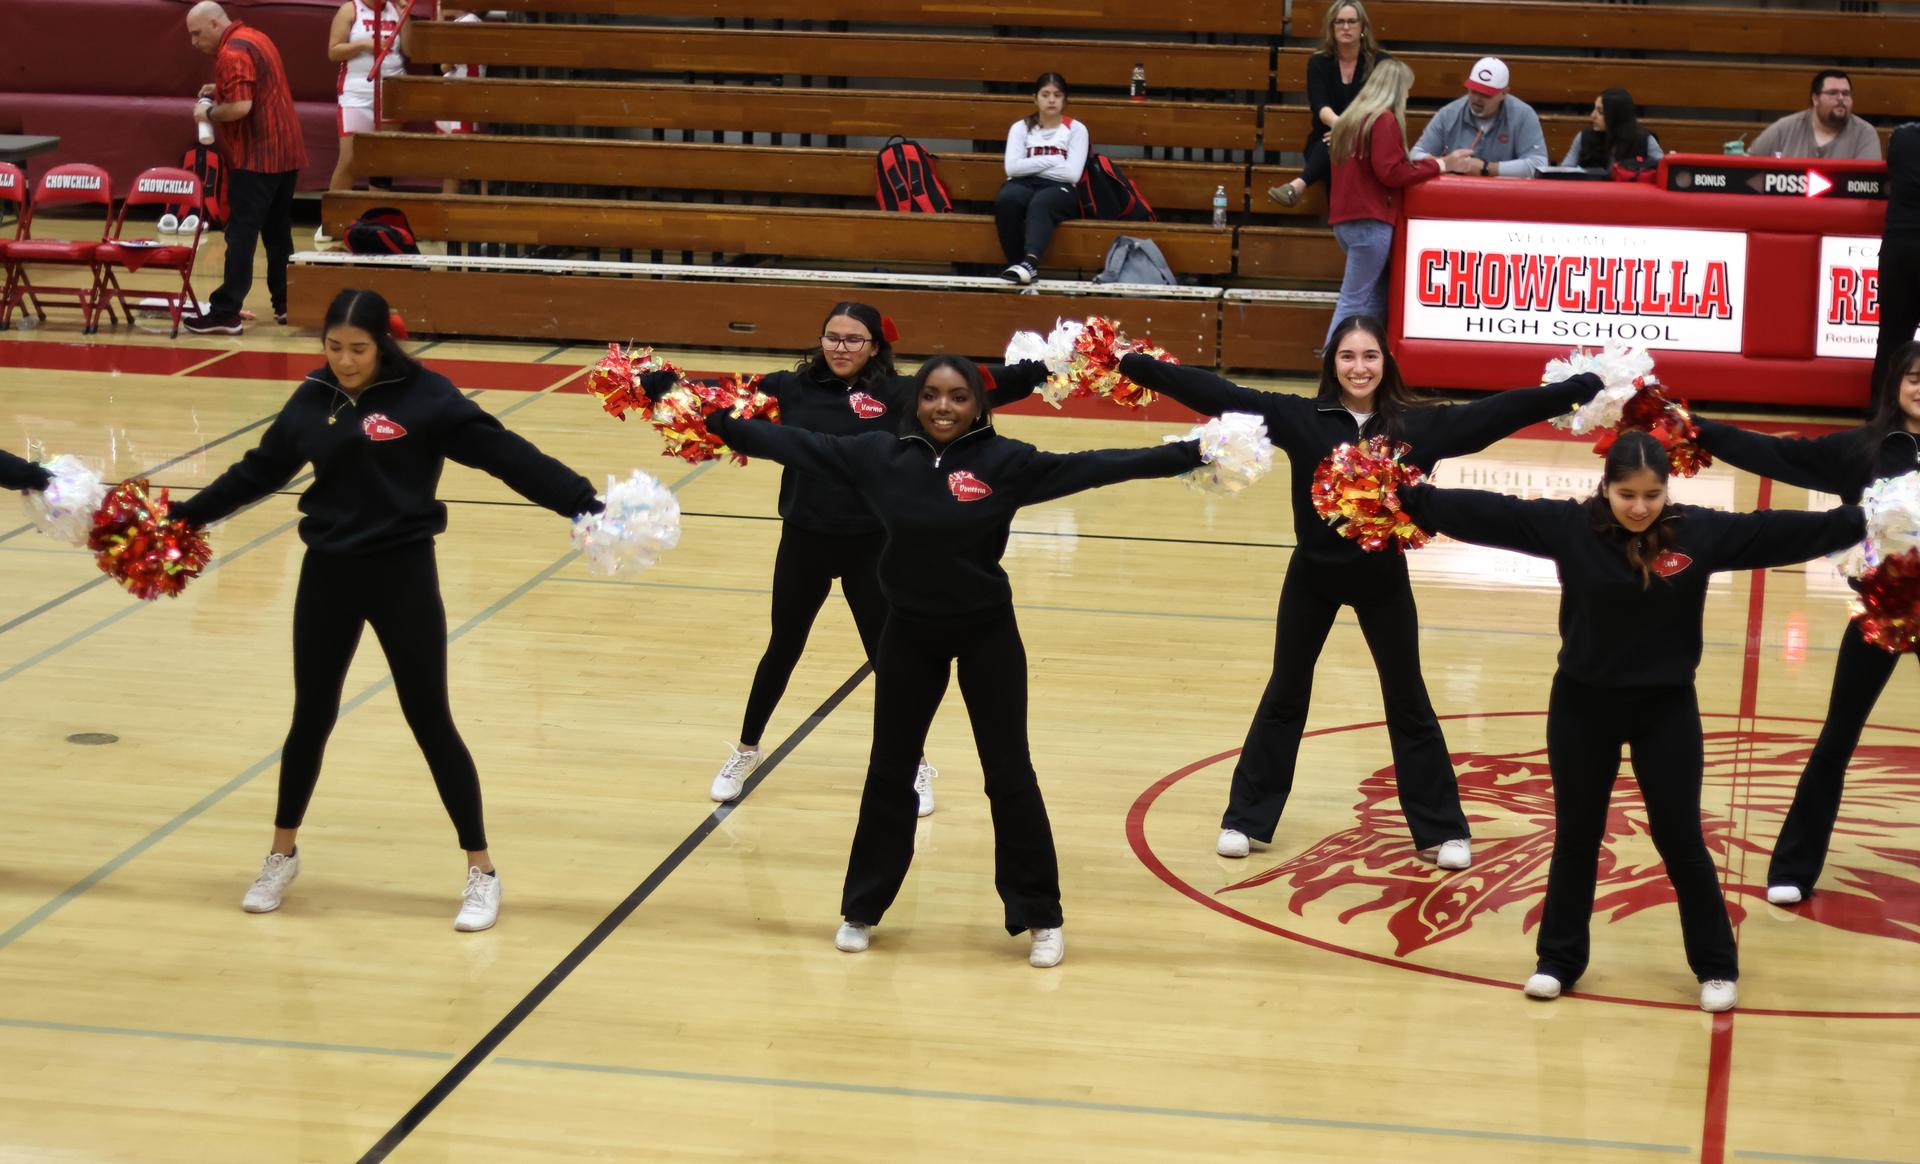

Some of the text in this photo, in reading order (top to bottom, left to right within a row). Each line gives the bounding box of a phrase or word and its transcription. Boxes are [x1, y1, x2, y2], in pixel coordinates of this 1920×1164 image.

[1478, 69, 1493, 82] C
[45, 175, 101, 190] CHOWCHILLA
[138, 178, 194, 194] CHOWCHILLA
[1694, 174, 1726, 187] BONUS
[1765, 173, 1809, 193] POSS
[1847, 180, 1880, 193] BONUS
[1417, 248, 1733, 320] CHOWCHILLA
[1466, 316, 1679, 342] HIGH SCHOOL
